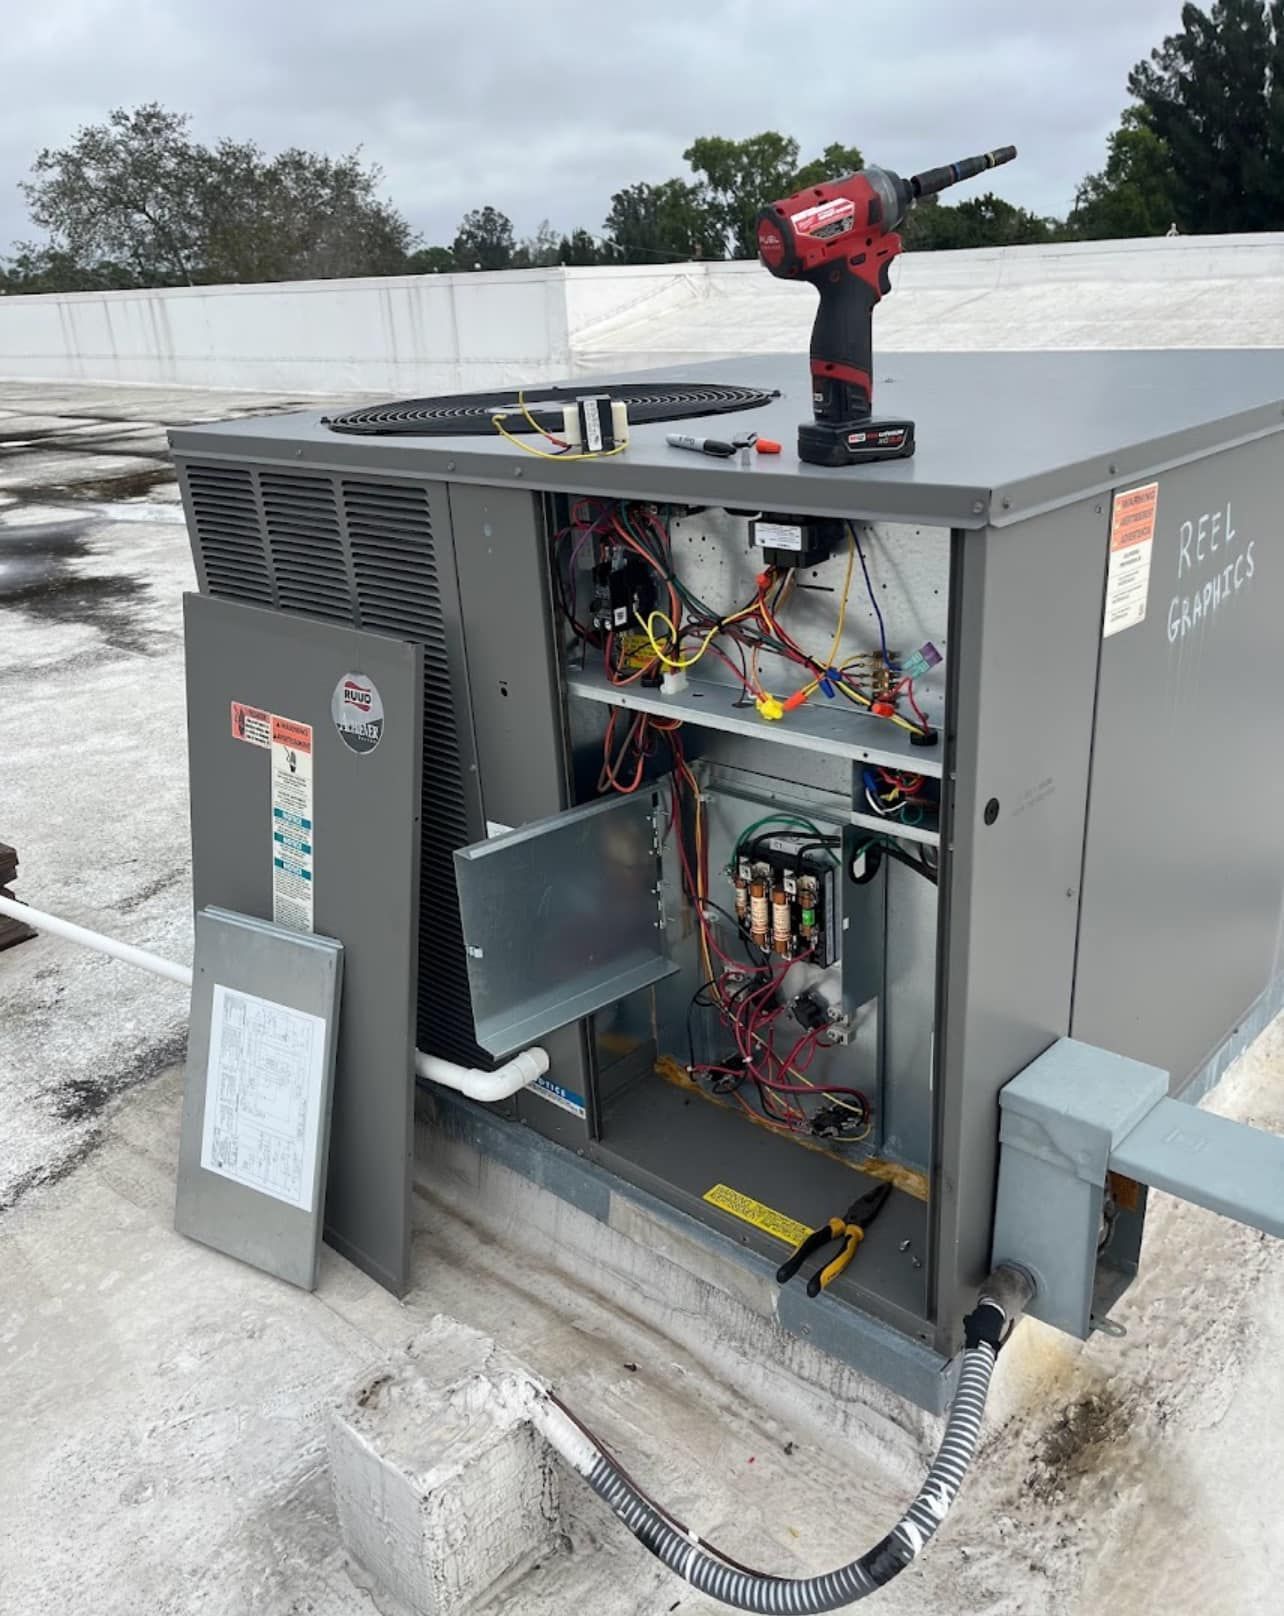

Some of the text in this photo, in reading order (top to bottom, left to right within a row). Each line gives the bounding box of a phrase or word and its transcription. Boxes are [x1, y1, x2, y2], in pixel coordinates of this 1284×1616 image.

[1178, 501, 1236, 579] REEL
[1167, 540, 1255, 643] GRAPHICS
[344, 689, 372, 704] RUUD
[537, 1078, 567, 1098] OTICE
